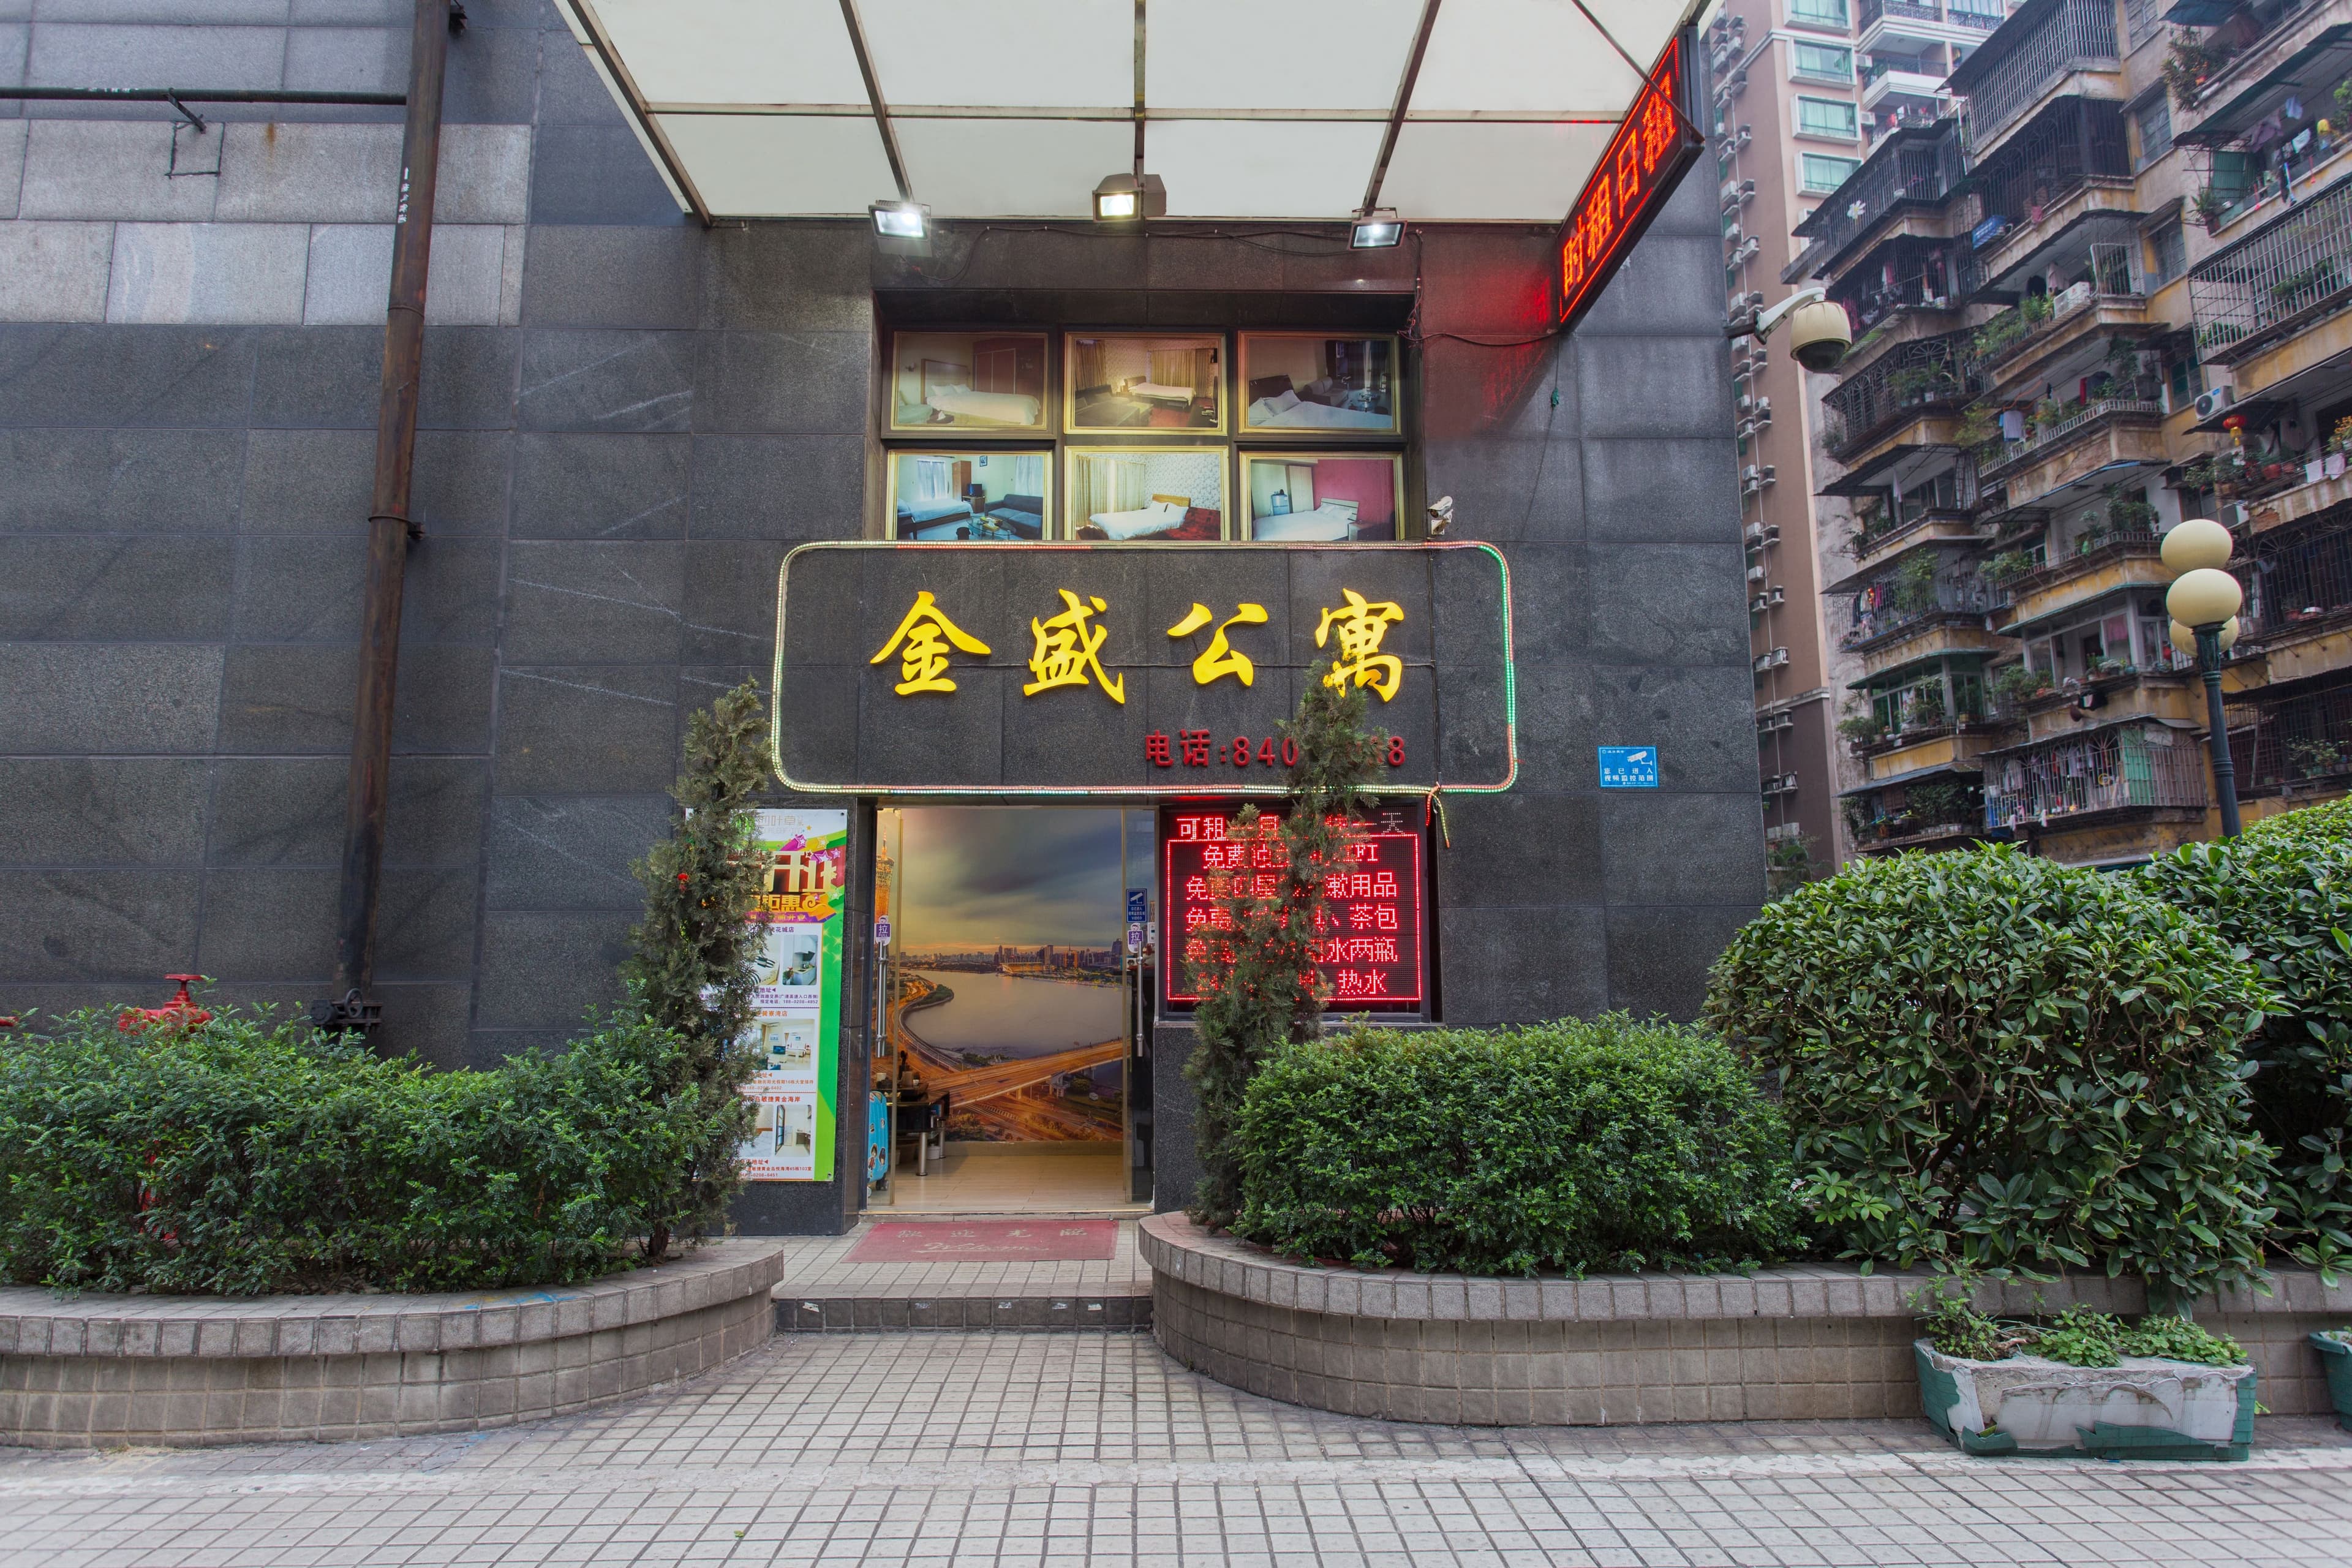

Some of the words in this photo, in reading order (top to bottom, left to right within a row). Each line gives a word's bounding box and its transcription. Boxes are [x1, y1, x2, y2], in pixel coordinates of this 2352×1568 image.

[1562, 70, 1677, 299] 时租日租
[870, 587, 1406, 704] 金盛公寓
[878, 924, 888, 933] 拉
[1131, 932, 1140, 941] 拉
